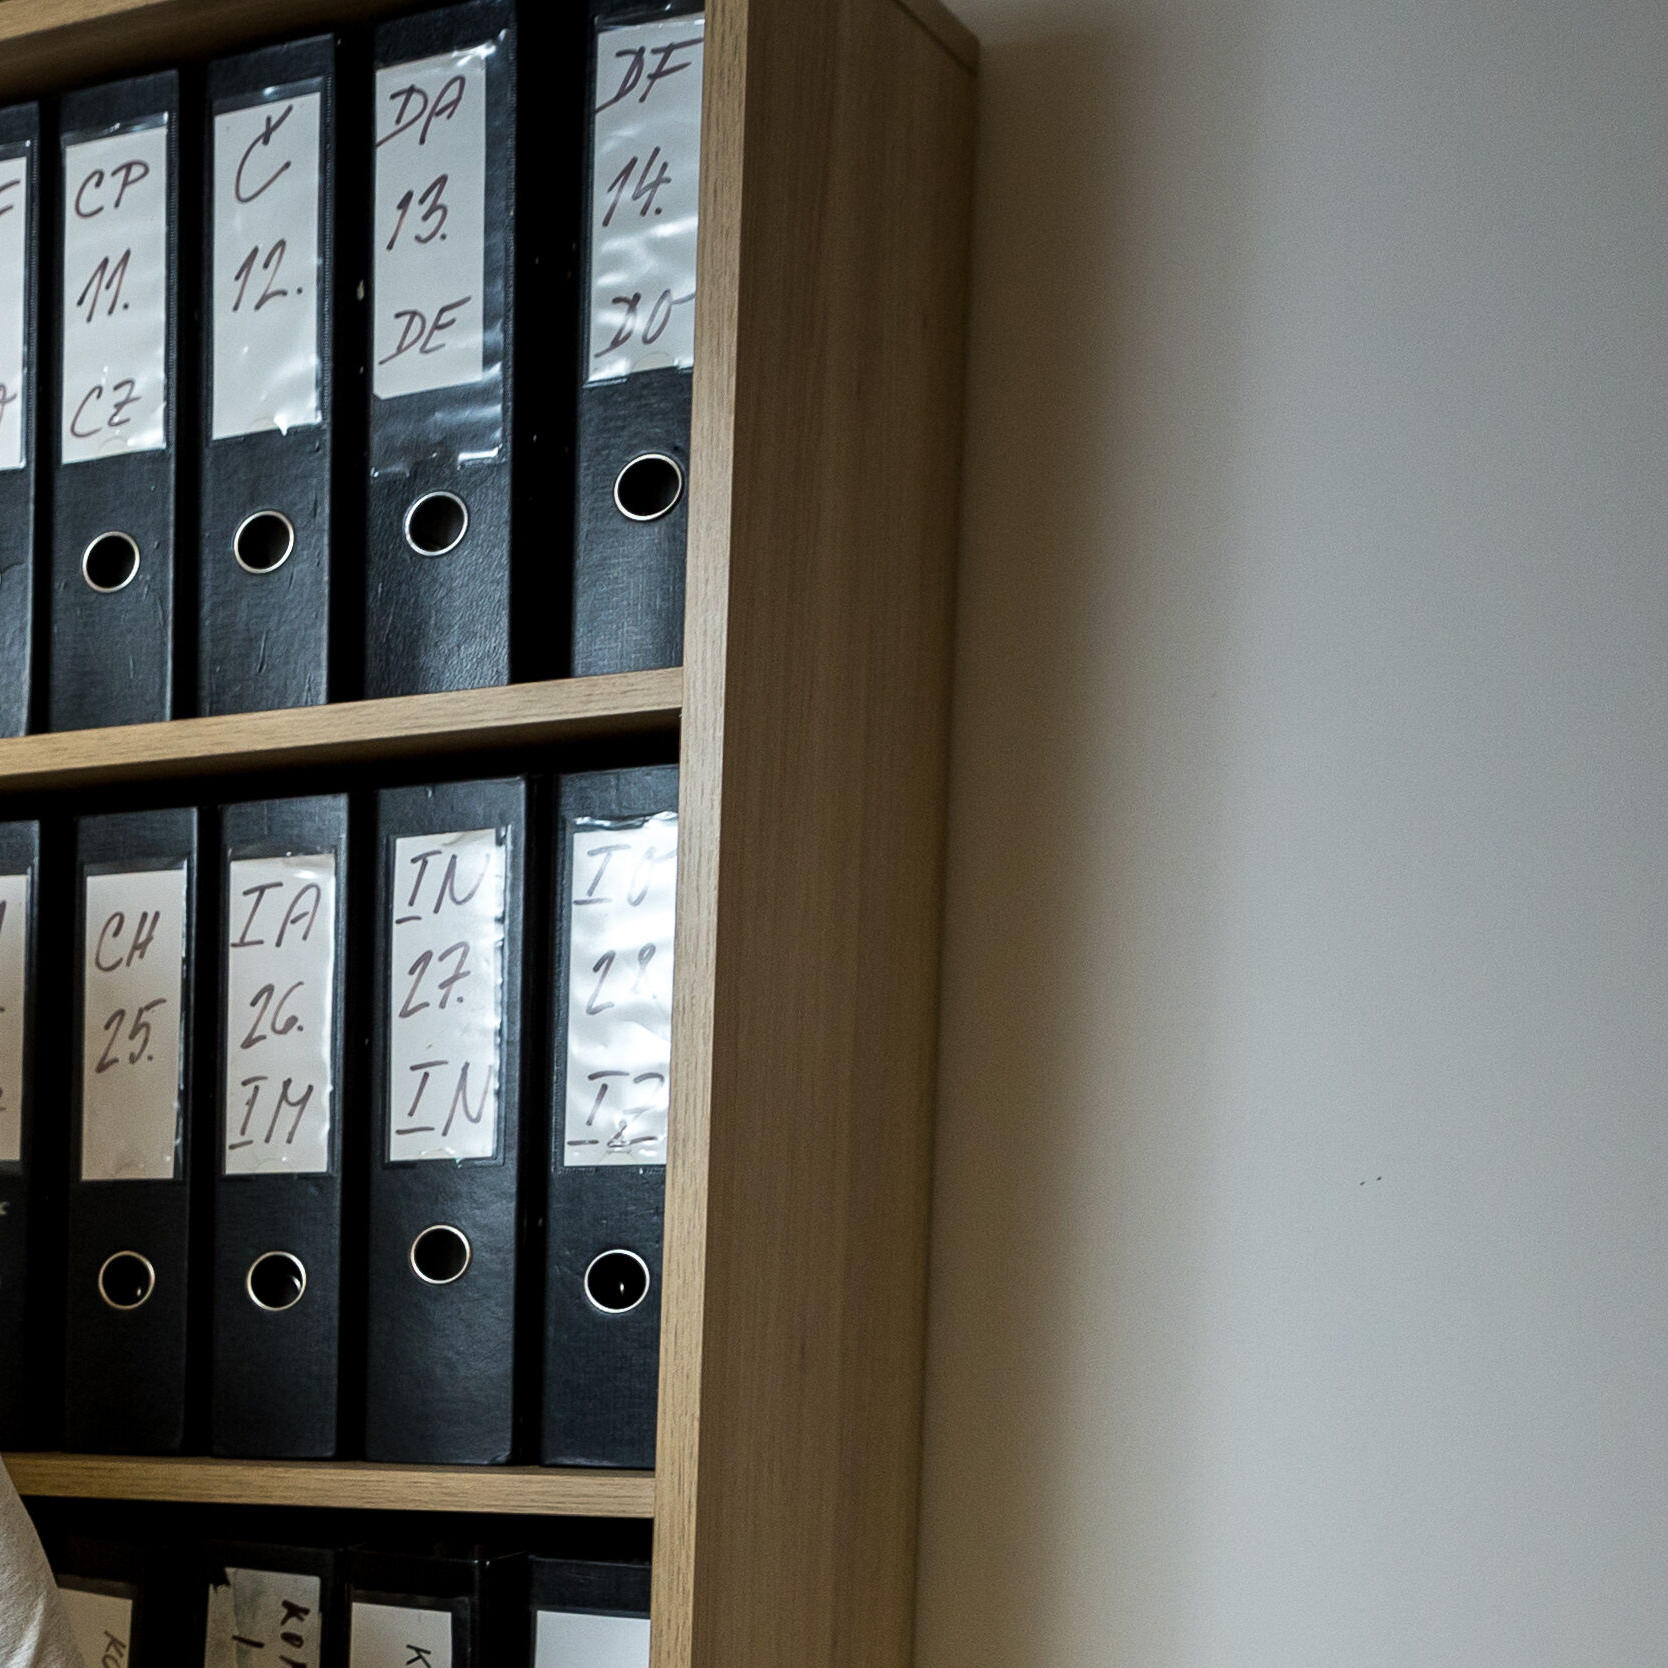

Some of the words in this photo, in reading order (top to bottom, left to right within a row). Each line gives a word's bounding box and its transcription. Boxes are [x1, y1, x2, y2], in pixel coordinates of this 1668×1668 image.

[374, 75, 467, 149] DA
[594, 38, 704, 115] DF
[73, 160, 149, 219] CP
[234, 105, 293, 203] Č
[602, 146, 671, 227] 14.
[386, 174, 448, 252] 13.
[76, 249, 130, 323] 11.
[232, 239, 303, 313] 12.
[379, 295, 472, 365] DE
[69, 379, 142, 438] CZ
[93, 911, 160, 973] CH
[230, 883, 322, 949] IA
[240, 982, 305, 1050] 26.
[399, 941, 471, 1020] 27.
[94, 999, 167, 1075] 25.
[228, 1076, 314, 1151] IM
